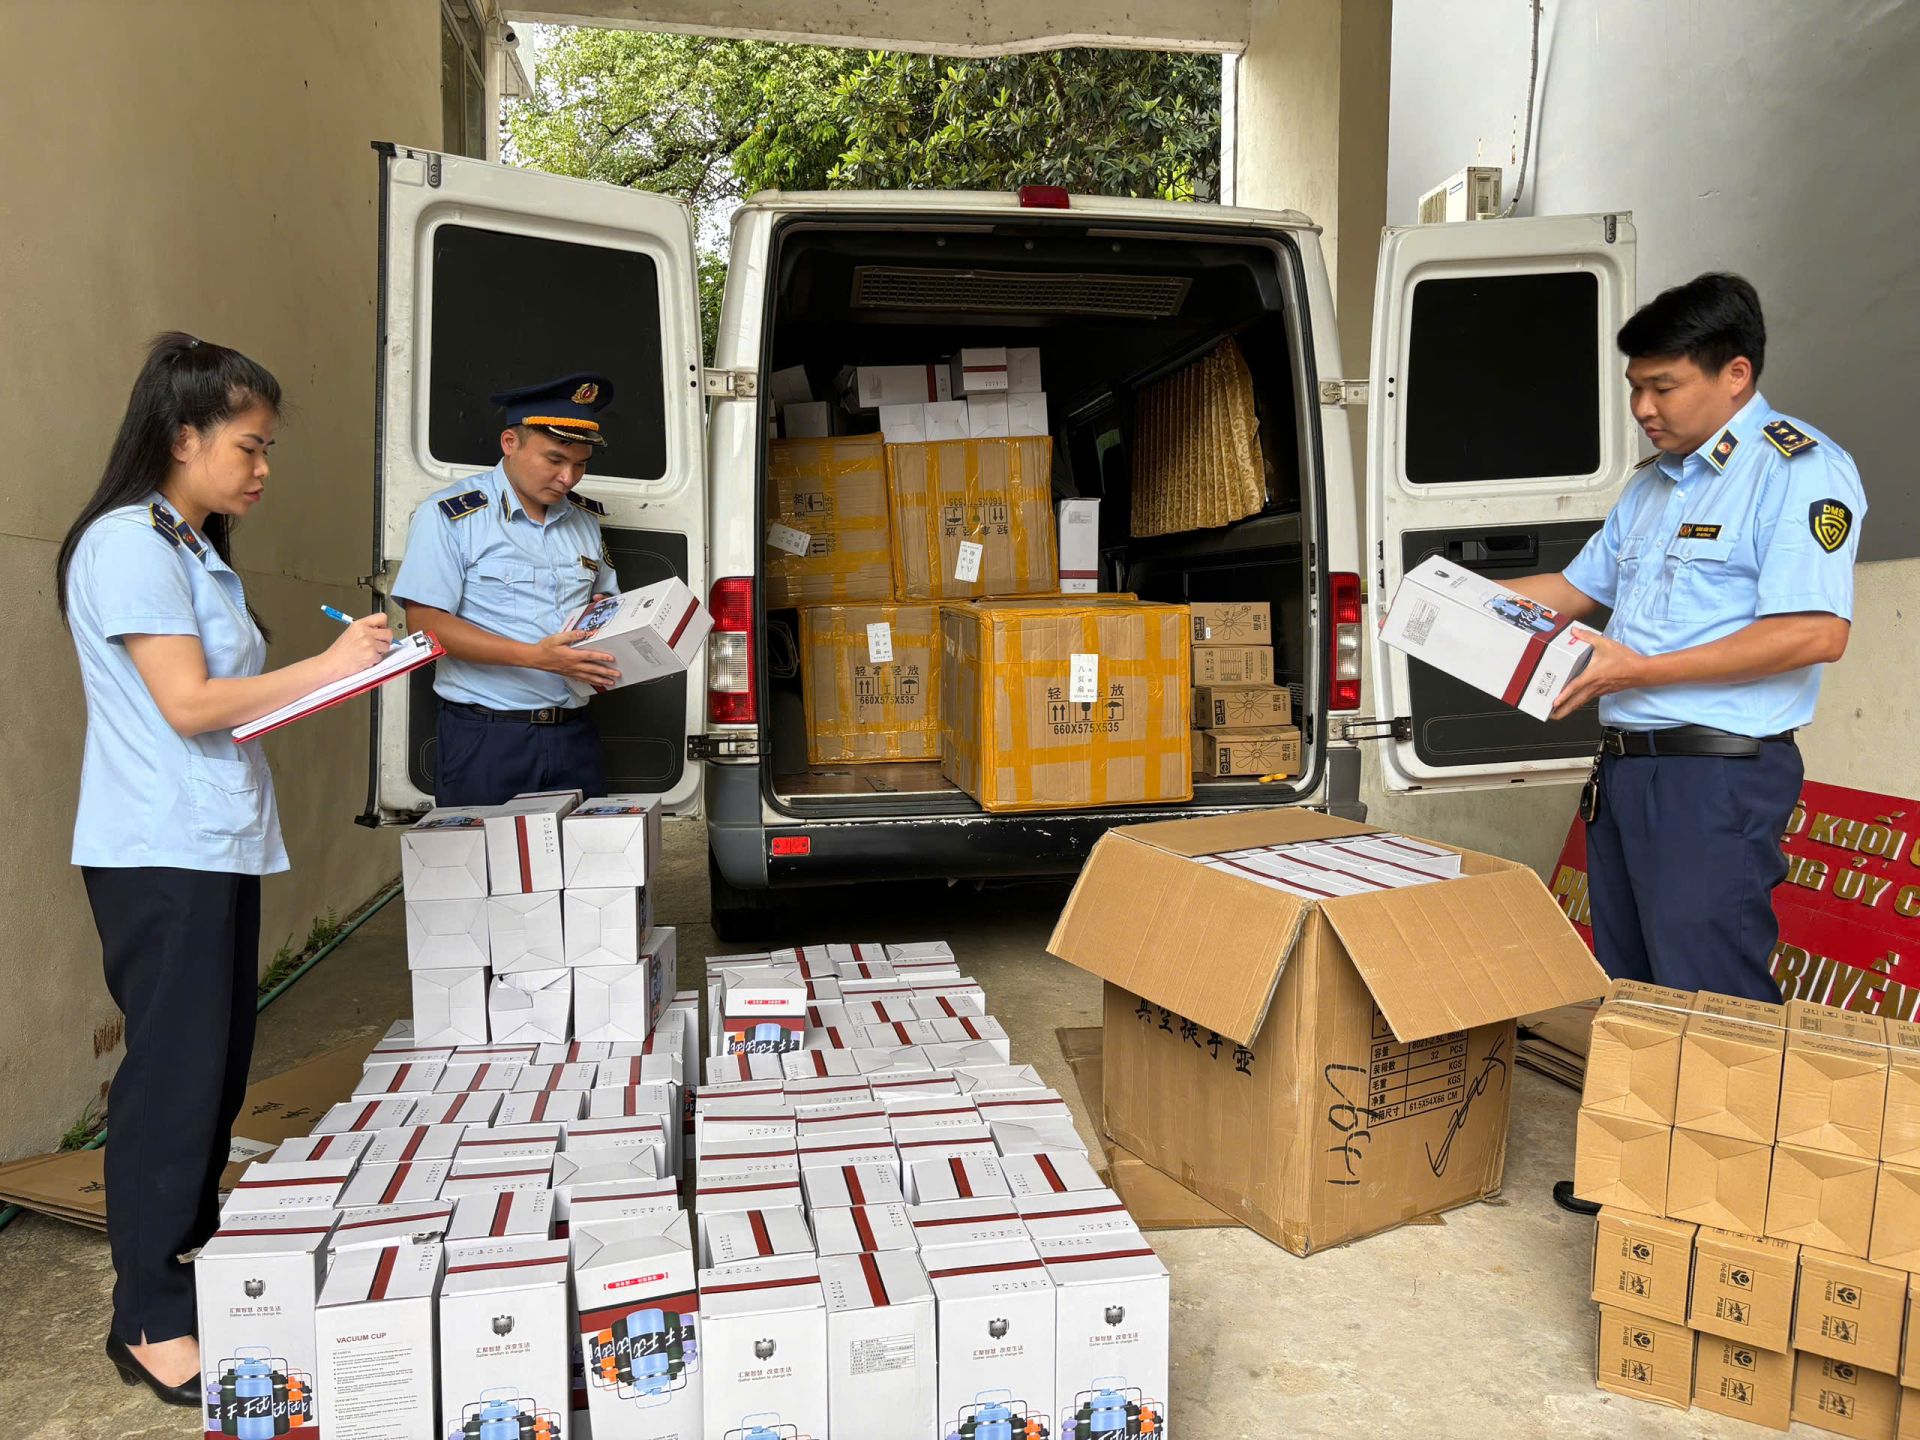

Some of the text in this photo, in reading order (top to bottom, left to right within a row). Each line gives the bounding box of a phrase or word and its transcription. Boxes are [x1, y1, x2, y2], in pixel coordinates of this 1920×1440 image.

[1823, 504, 1845, 518] DMS
[1053, 722, 1120, 735] 660X575X535
[1808, 811, 1907, 861] KHỐI
[1374, 1046, 1389, 1059] 容量
[1430, 1044, 1464, 1061] 32 PCS
[1448, 1060, 1462, 1071] KGS
[1372, 1078, 1387, 1090] 毛重
[1447, 1075, 1461, 1086] KGS
[1371, 1094, 1386, 1107] 净重
[1447, 1090, 1458, 1100] CM
[336, 1332, 387, 1344] VACUUM CUP
